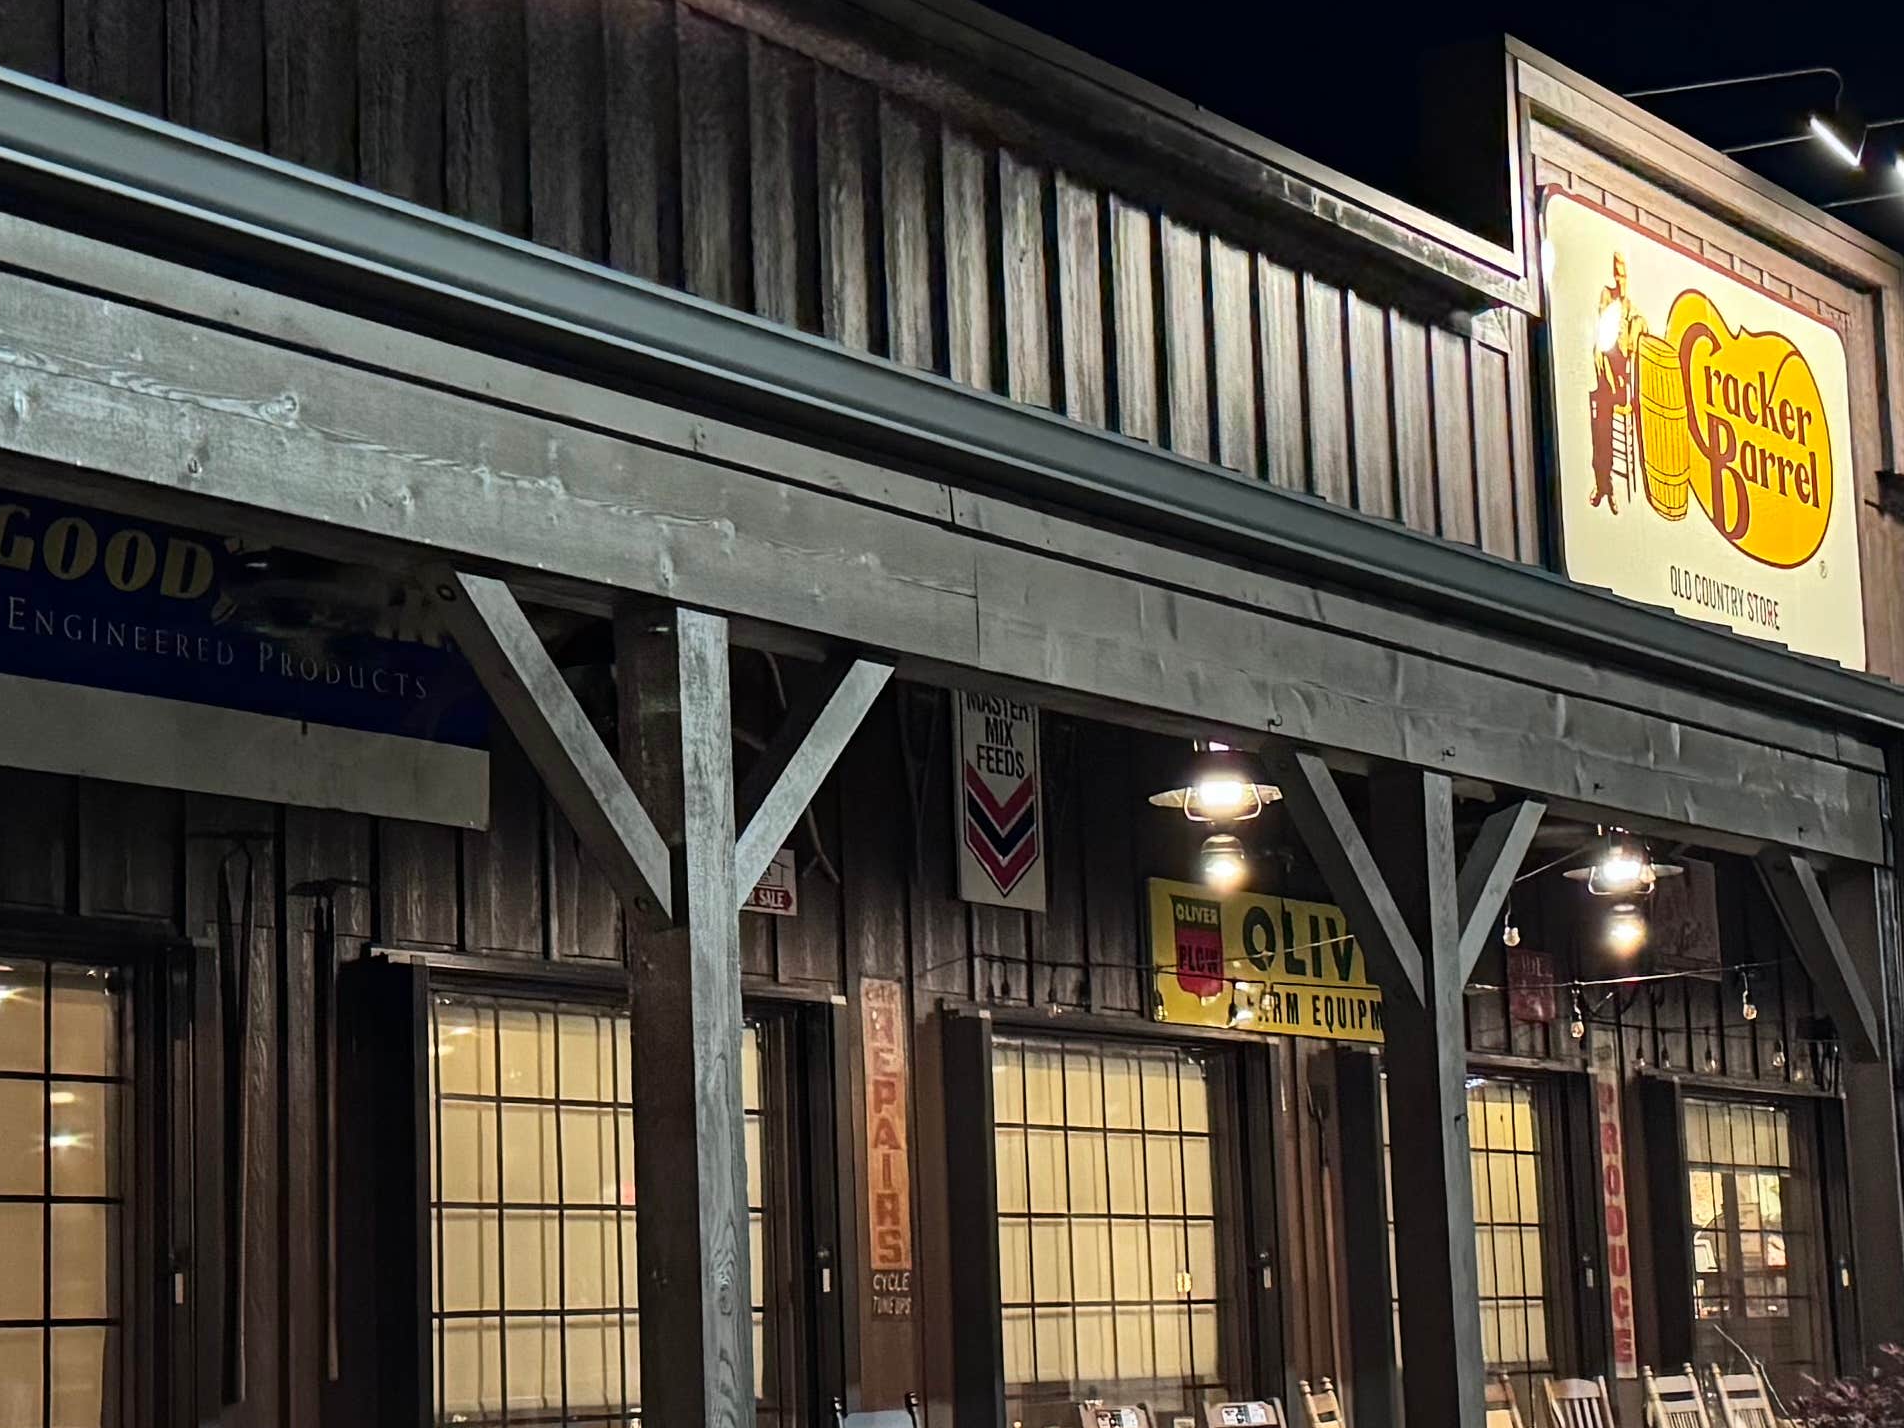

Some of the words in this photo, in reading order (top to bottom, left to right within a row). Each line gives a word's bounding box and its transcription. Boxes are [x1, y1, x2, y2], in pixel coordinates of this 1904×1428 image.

[1679, 322, 1811, 457] Cracker
[1704, 410, 1820, 540] Barrel
[1669, 565, 1692, 600] OLD
[1694, 574, 1744, 617] COUNTRY
[1746, 591, 1780, 631] STORE
[7, 595, 234, 666] ENGINEERED
[258, 641, 429, 701] PRODUCTS
[977, 743, 1025, 779] FEEDS
[985, 716, 1014, 748] MIX
[1175, 903, 1219, 925] OLIVER
[1242, 905, 1355, 982] OLIV
[1311, 994, 1385, 1034] EQUIPM
[872, 1005, 902, 1264] REPAIRS
[872, 1271, 911, 1293] CYCLE
